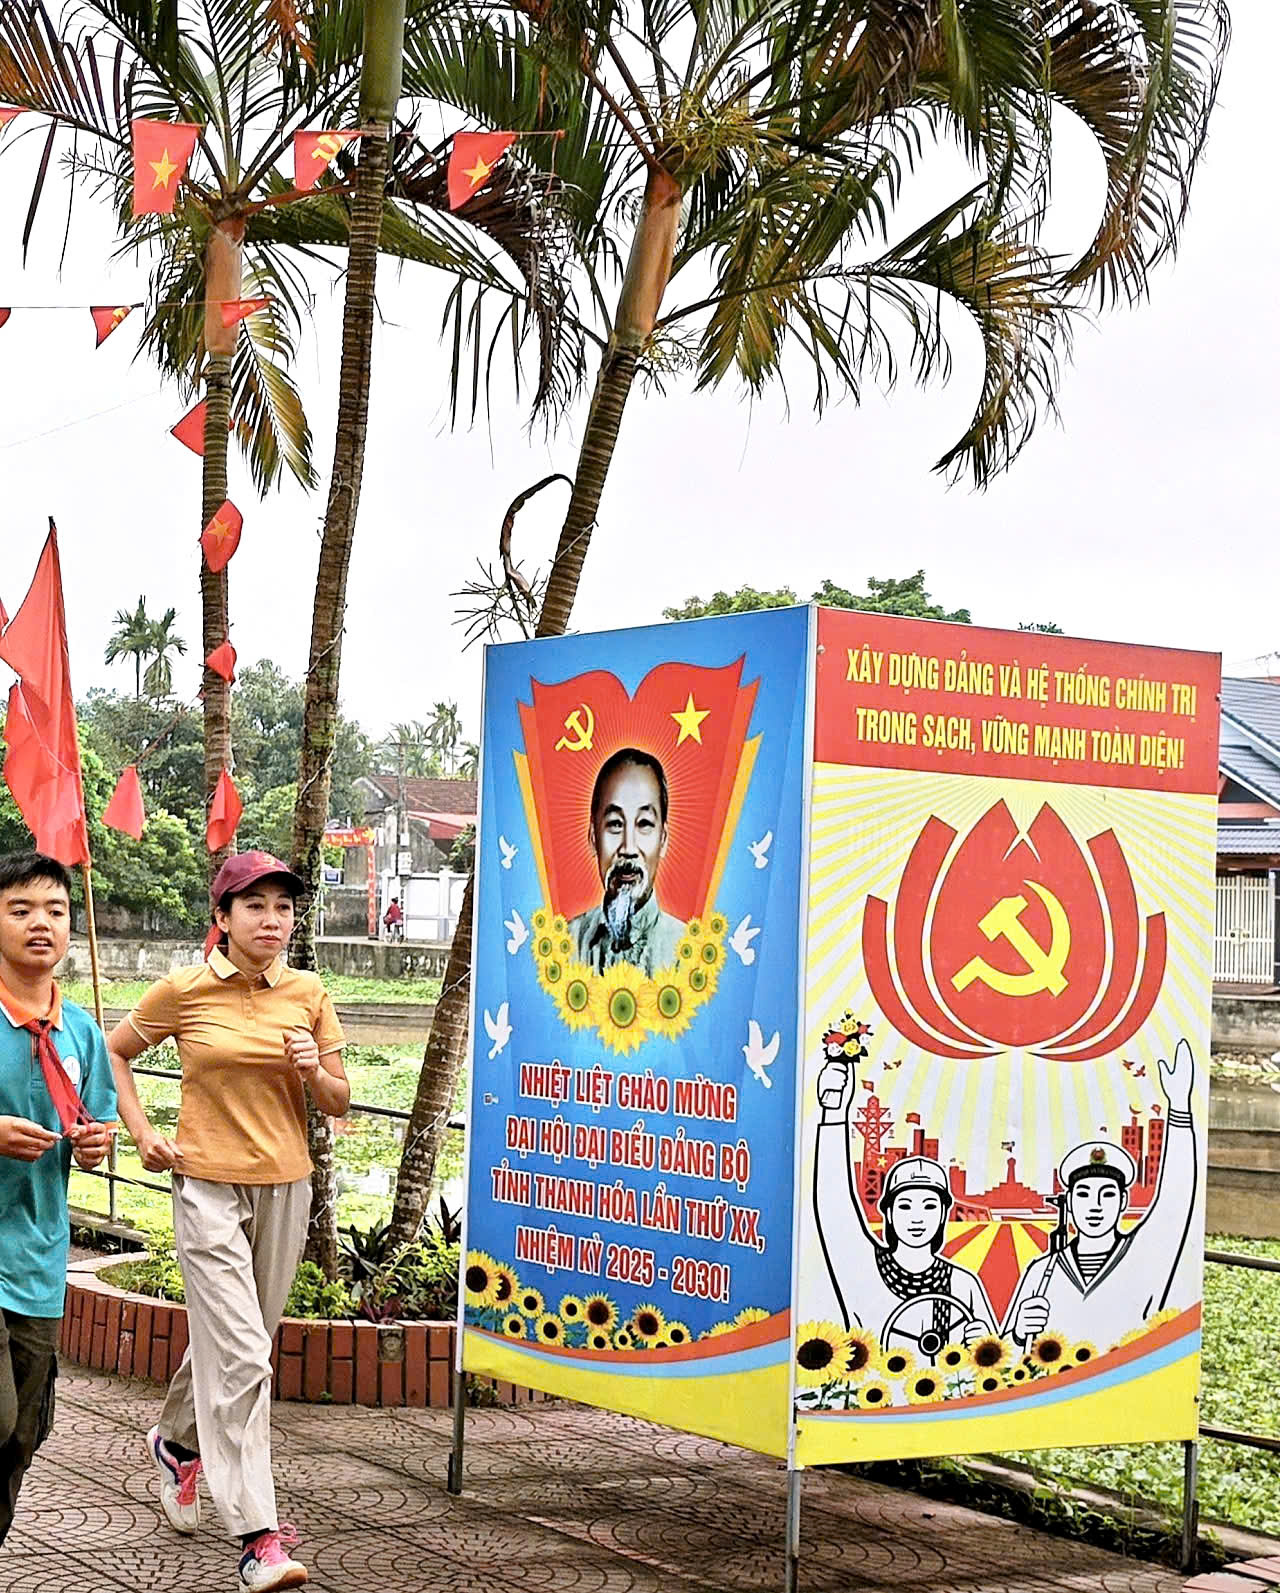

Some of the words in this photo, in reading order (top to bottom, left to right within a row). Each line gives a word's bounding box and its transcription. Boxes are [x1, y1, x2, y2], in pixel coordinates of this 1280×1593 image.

[846, 643, 884, 684] XÂY
[888, 652, 939, 695] DỰNG
[944, 650, 994, 696] ĐẢNG
[999, 659, 1022, 699] VÀ
[1026, 662, 1049, 709] HỆ
[1054, 663, 1111, 708] THỐNG
[1115, 673, 1167, 713] CHÍNH
[1171, 683, 1197, 723] TRỊ
[855, 707, 917, 746] TRONG
[922, 714, 976, 756] SẠCH,
[981, 714, 1029, 756] VỮNG
[1033, 725, 1086, 766] MẠNH
[1091, 725, 1136, 765] TOÀN
[1139, 730, 1185, 775] DIỆN!
[520, 1060, 572, 1108] NHIỆT
[575, 1064, 614, 1112] LIỆT
[617, 1069, 670, 1114] CHÀO
[674, 1074, 737, 1122] MỪNG
[506, 1115, 536, 1158] ĐẠI
[540, 1114, 571, 1163] HỘI
[574, 1123, 607, 1169] ĐẠI
[610, 1119, 655, 1170] BIỂU
[659, 1126, 716, 1180] ĐẢNG
[720, 1138, 750, 1193] BỘ
[491, 1158, 531, 1207] TỈNH
[534, 1173, 595, 1218] THANH
[598, 1180, 637, 1226] HÓA
[641, 1182, 681, 1233] LẦN
[685, 1196, 728, 1241] THỨ
[728, 1205, 765, 1254] XX,
[515, 1225, 575, 1274] NHIỆM
[578, 1232, 603, 1275] KỲ
[606, 1243, 655, 1287] 2025
[658, 1267, 669, 1280] -
[671, 1255, 730, 1304] 2030!
